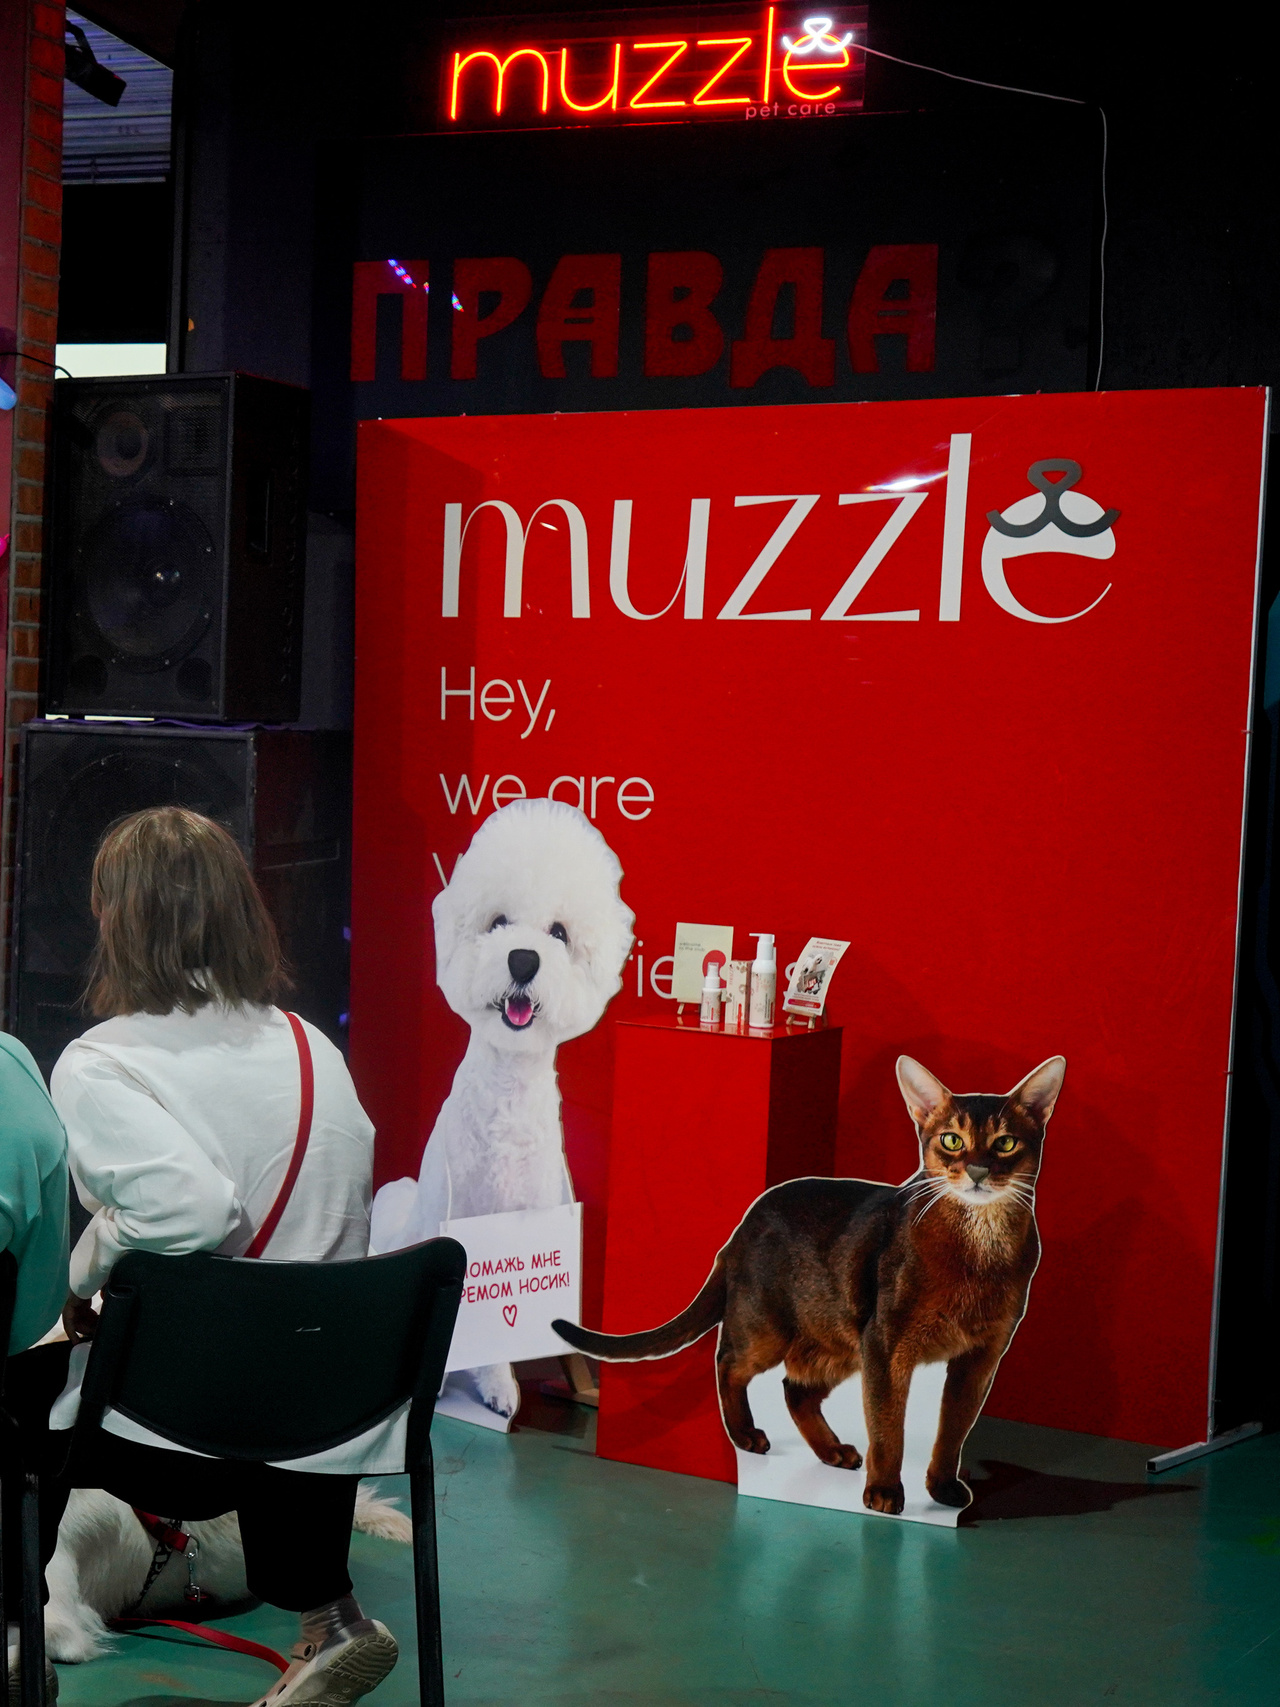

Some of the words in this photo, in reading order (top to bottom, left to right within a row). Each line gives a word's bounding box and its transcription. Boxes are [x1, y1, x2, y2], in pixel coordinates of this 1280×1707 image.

[450, 5, 852, 121] muzzle
[745, 101, 780, 121] pet
[787, 102, 836, 116] care
[441, 432, 1120, 624] muzzle
[439, 666, 556, 739] Hey,
[547, 775, 655, 821] are
[531, 1250, 561, 1270] МНЕ
[459, 1280, 513, 1304] РЕМОМ
[518, 1272, 570, 1294] НОСИК!
